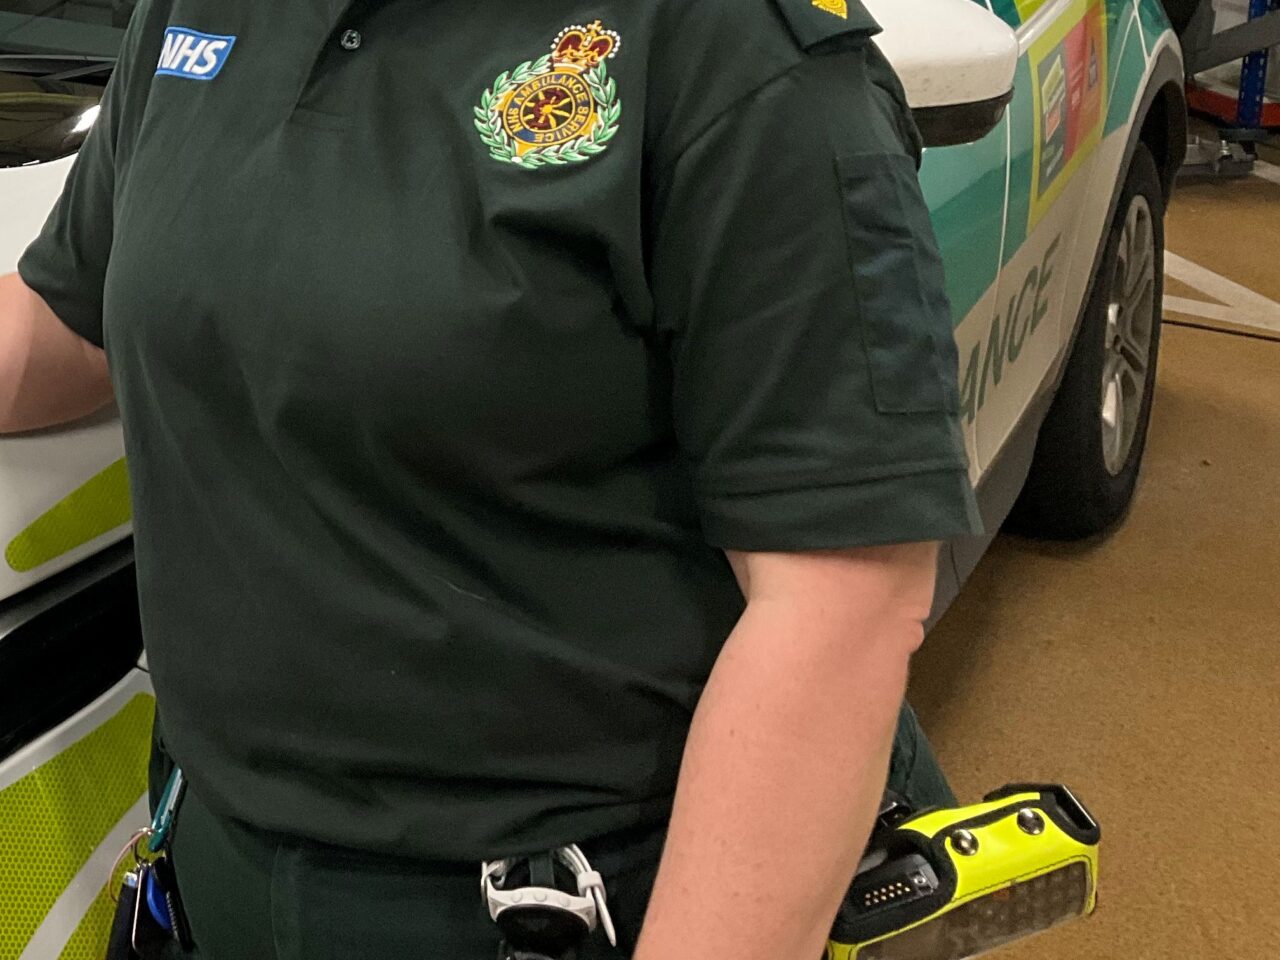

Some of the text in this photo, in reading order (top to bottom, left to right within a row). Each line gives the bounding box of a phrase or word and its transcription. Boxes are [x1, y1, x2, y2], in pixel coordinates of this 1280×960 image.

[157, 33, 228, 74] NHS
[509, 75, 590, 143] NHS AMBULANCE SERVICE
